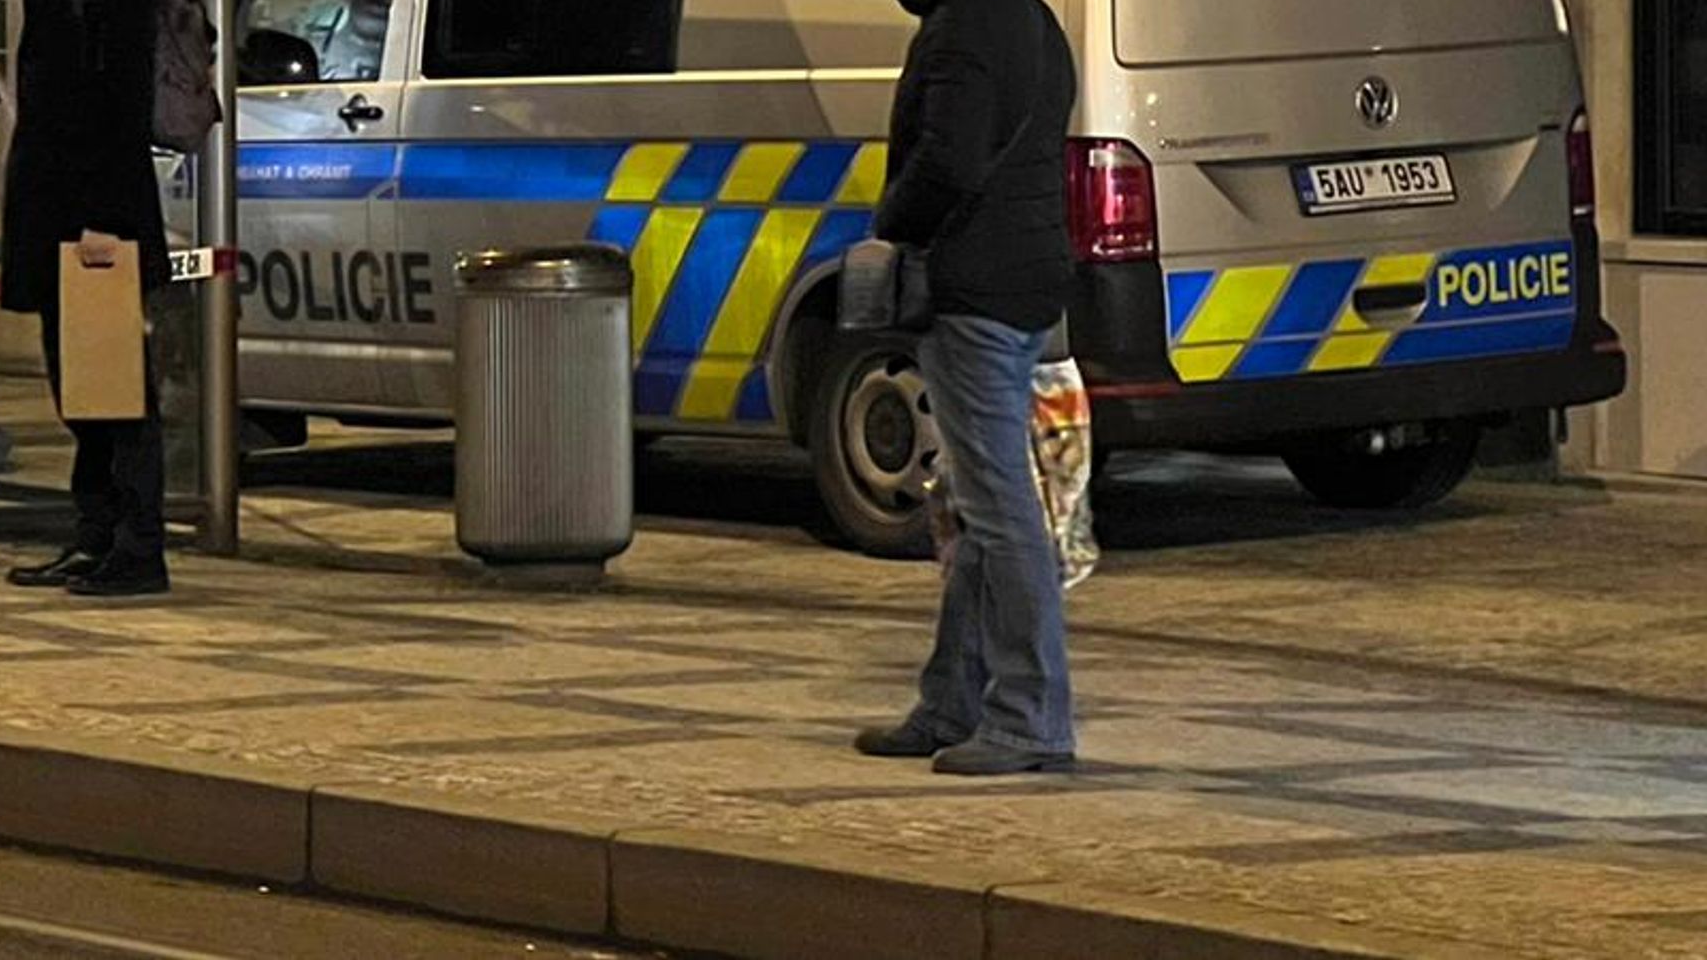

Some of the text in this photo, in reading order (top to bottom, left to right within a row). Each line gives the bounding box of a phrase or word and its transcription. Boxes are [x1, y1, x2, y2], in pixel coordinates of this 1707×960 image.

[1316, 160, 1439, 199] 5AU 1953
[236, 248, 436, 325] POLICIE
[1437, 251, 1571, 308] POLICIE
